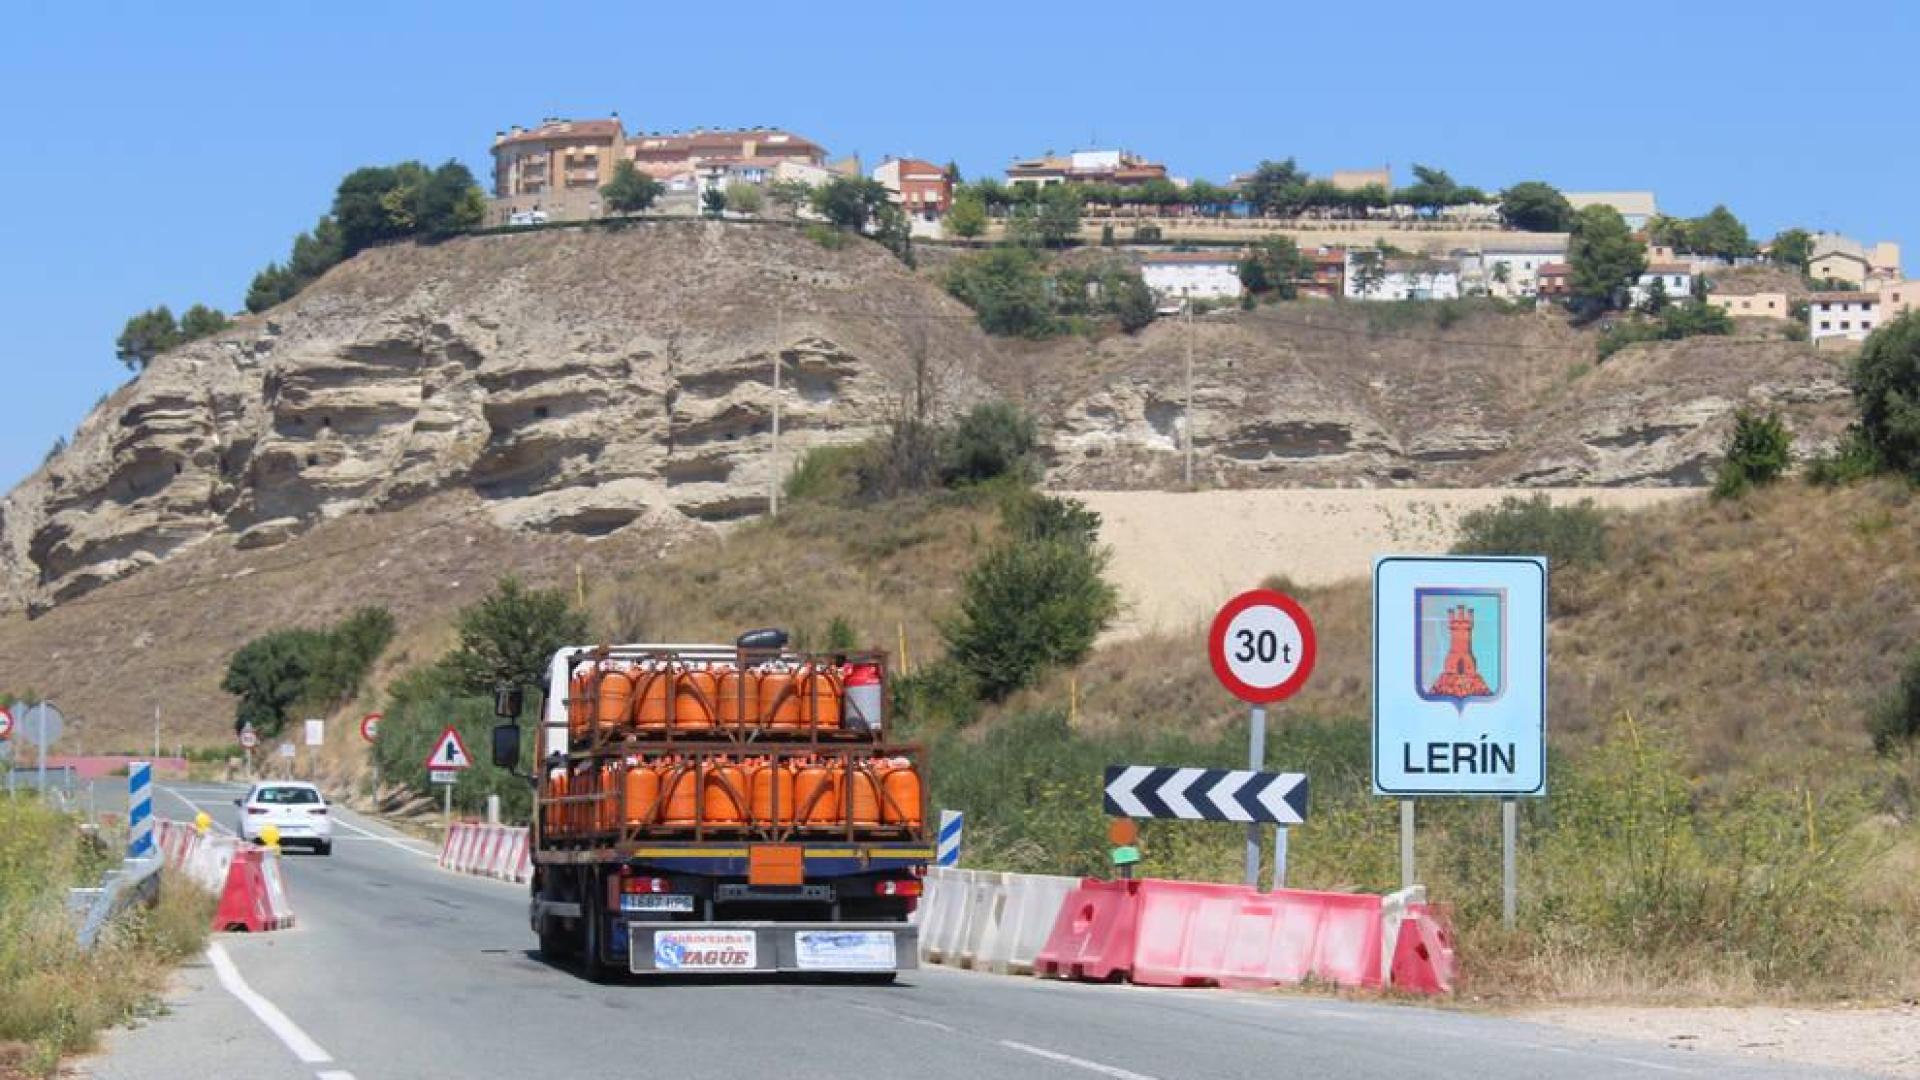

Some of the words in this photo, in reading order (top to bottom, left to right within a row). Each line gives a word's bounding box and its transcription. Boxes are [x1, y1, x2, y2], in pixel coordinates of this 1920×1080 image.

[1235, 629, 1277, 663] 30
[1282, 643, 1291, 664] t
[1403, 733, 1516, 774] LERÍN
